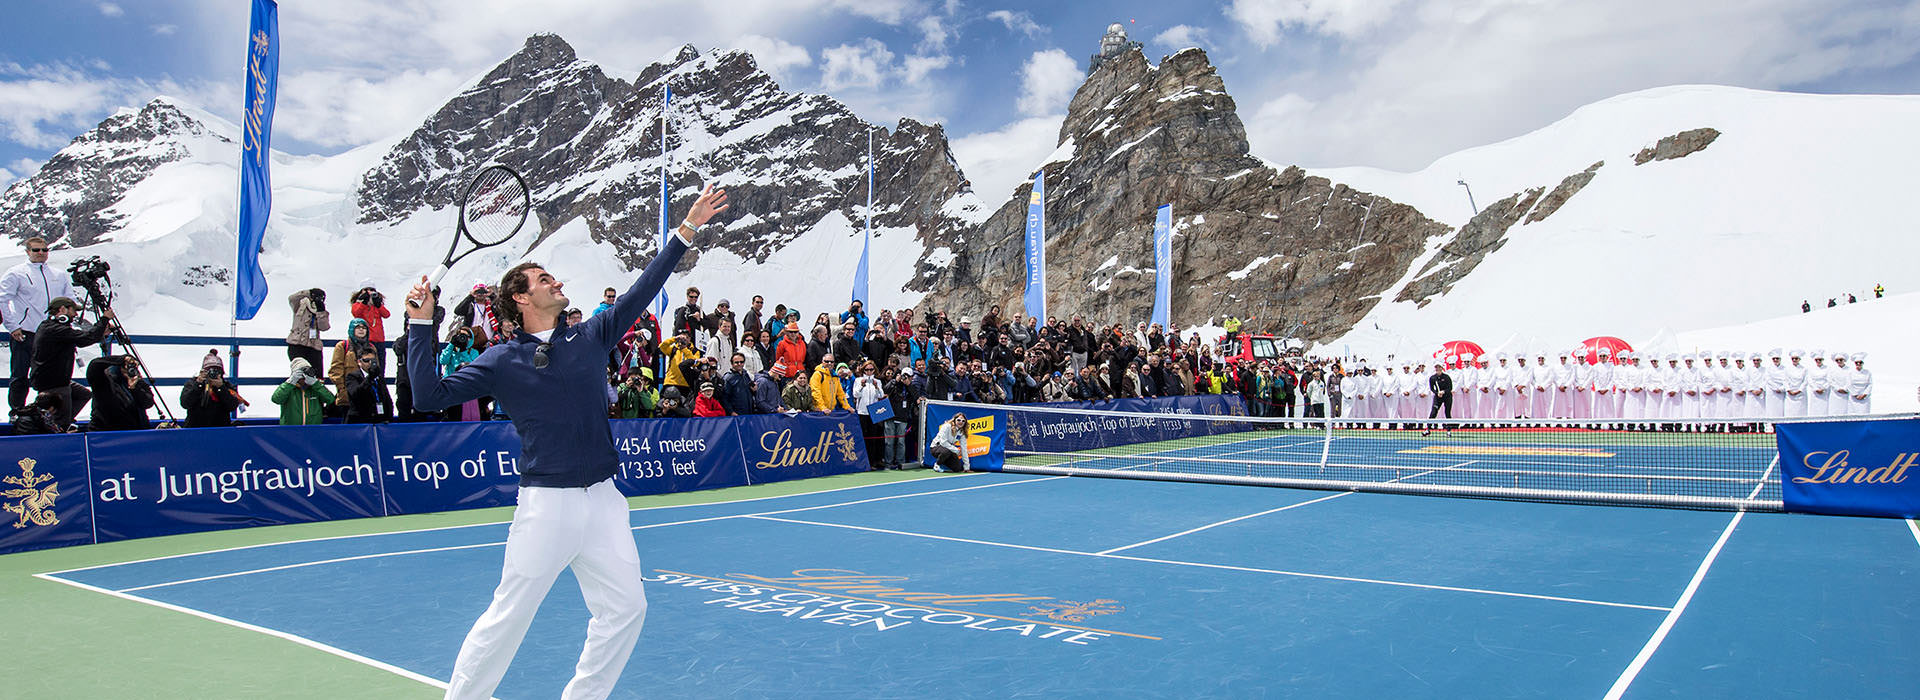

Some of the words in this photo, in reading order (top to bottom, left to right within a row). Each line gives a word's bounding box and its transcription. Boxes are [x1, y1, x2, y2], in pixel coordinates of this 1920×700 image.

[243, 53, 266, 167] Lindt
[970, 420, 988, 431] RAU
[1028, 423, 1039, 437] at
[1040, 416, 1097, 439] Jungfraujoch
[615, 437, 651, 456] '454
[659, 438, 706, 454] meters
[755, 428, 835, 470] Lindt
[100, 472, 138, 502] at
[157, 454, 375, 504] Jungfraujoch
[460, 450, 487, 479] of
[613, 460, 664, 481] 1'333
[671, 457, 698, 477] feet
[1792, 450, 1919, 484] Lindt
[725, 568, 1056, 606] Lindt
[642, 574, 776, 596] SWISS
[771, 592, 1111, 645] CHOCOLATE
[704, 596, 912, 631] HEAVEN
